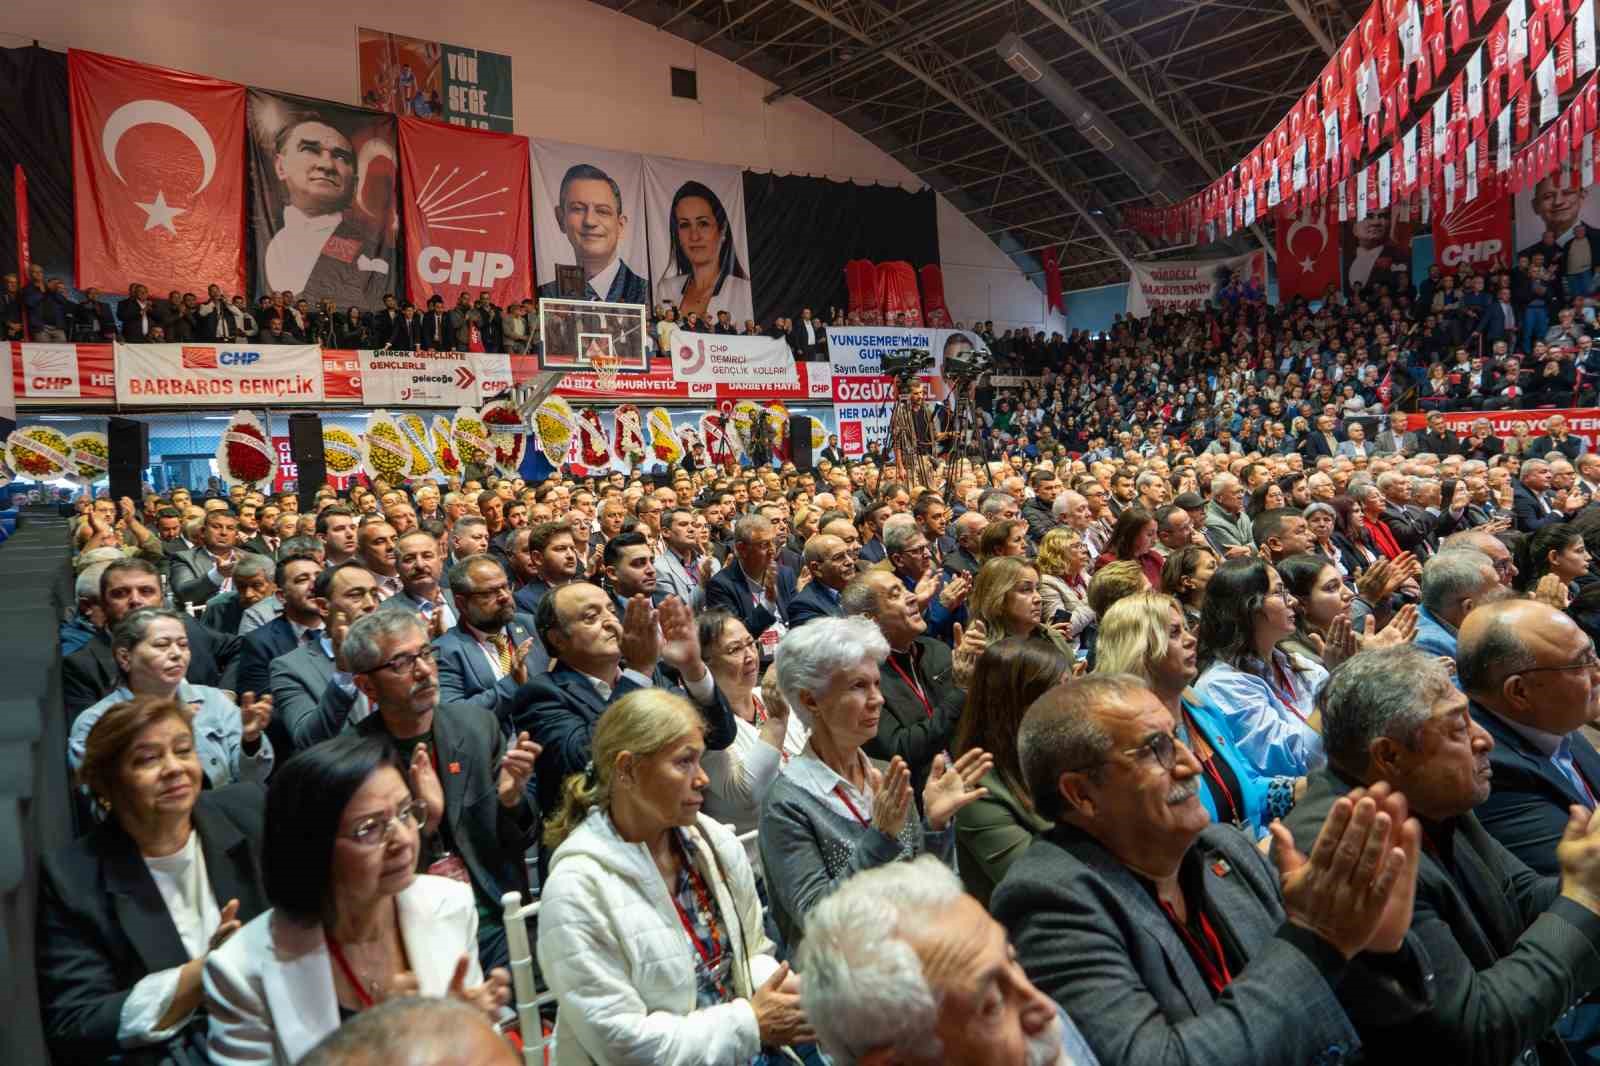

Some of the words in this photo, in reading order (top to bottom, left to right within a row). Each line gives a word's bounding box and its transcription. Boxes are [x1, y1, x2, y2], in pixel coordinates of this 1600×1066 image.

[1441, 239, 1503, 267] CHP
[417, 246, 514, 288] CHP
[830, 334, 929, 347] YUNUSEMRE'MİZİN
[710, 345, 728, 353] CHP
[219, 352, 260, 365] CHP
[369, 362, 427, 371] GENÇLERLE
[834, 364, 857, 375] Sayın
[32, 376, 72, 390] CHP
[412, 375, 453, 384] geleceğe
[575, 378, 592, 389] BİZ
[594, 377, 677, 390] CMHURİYETİZ
[129, 379, 233, 395] BARBAROS
[239, 375, 313, 397] GENÇLİK
[482, 381, 508, 391] CHP
[692, 383, 712, 393] CHP
[811, 384, 829, 393] CHP
[838, 379, 894, 400] ÖZGÜR
[839, 408, 859, 418] HER
[844, 442, 861, 451] CHP
